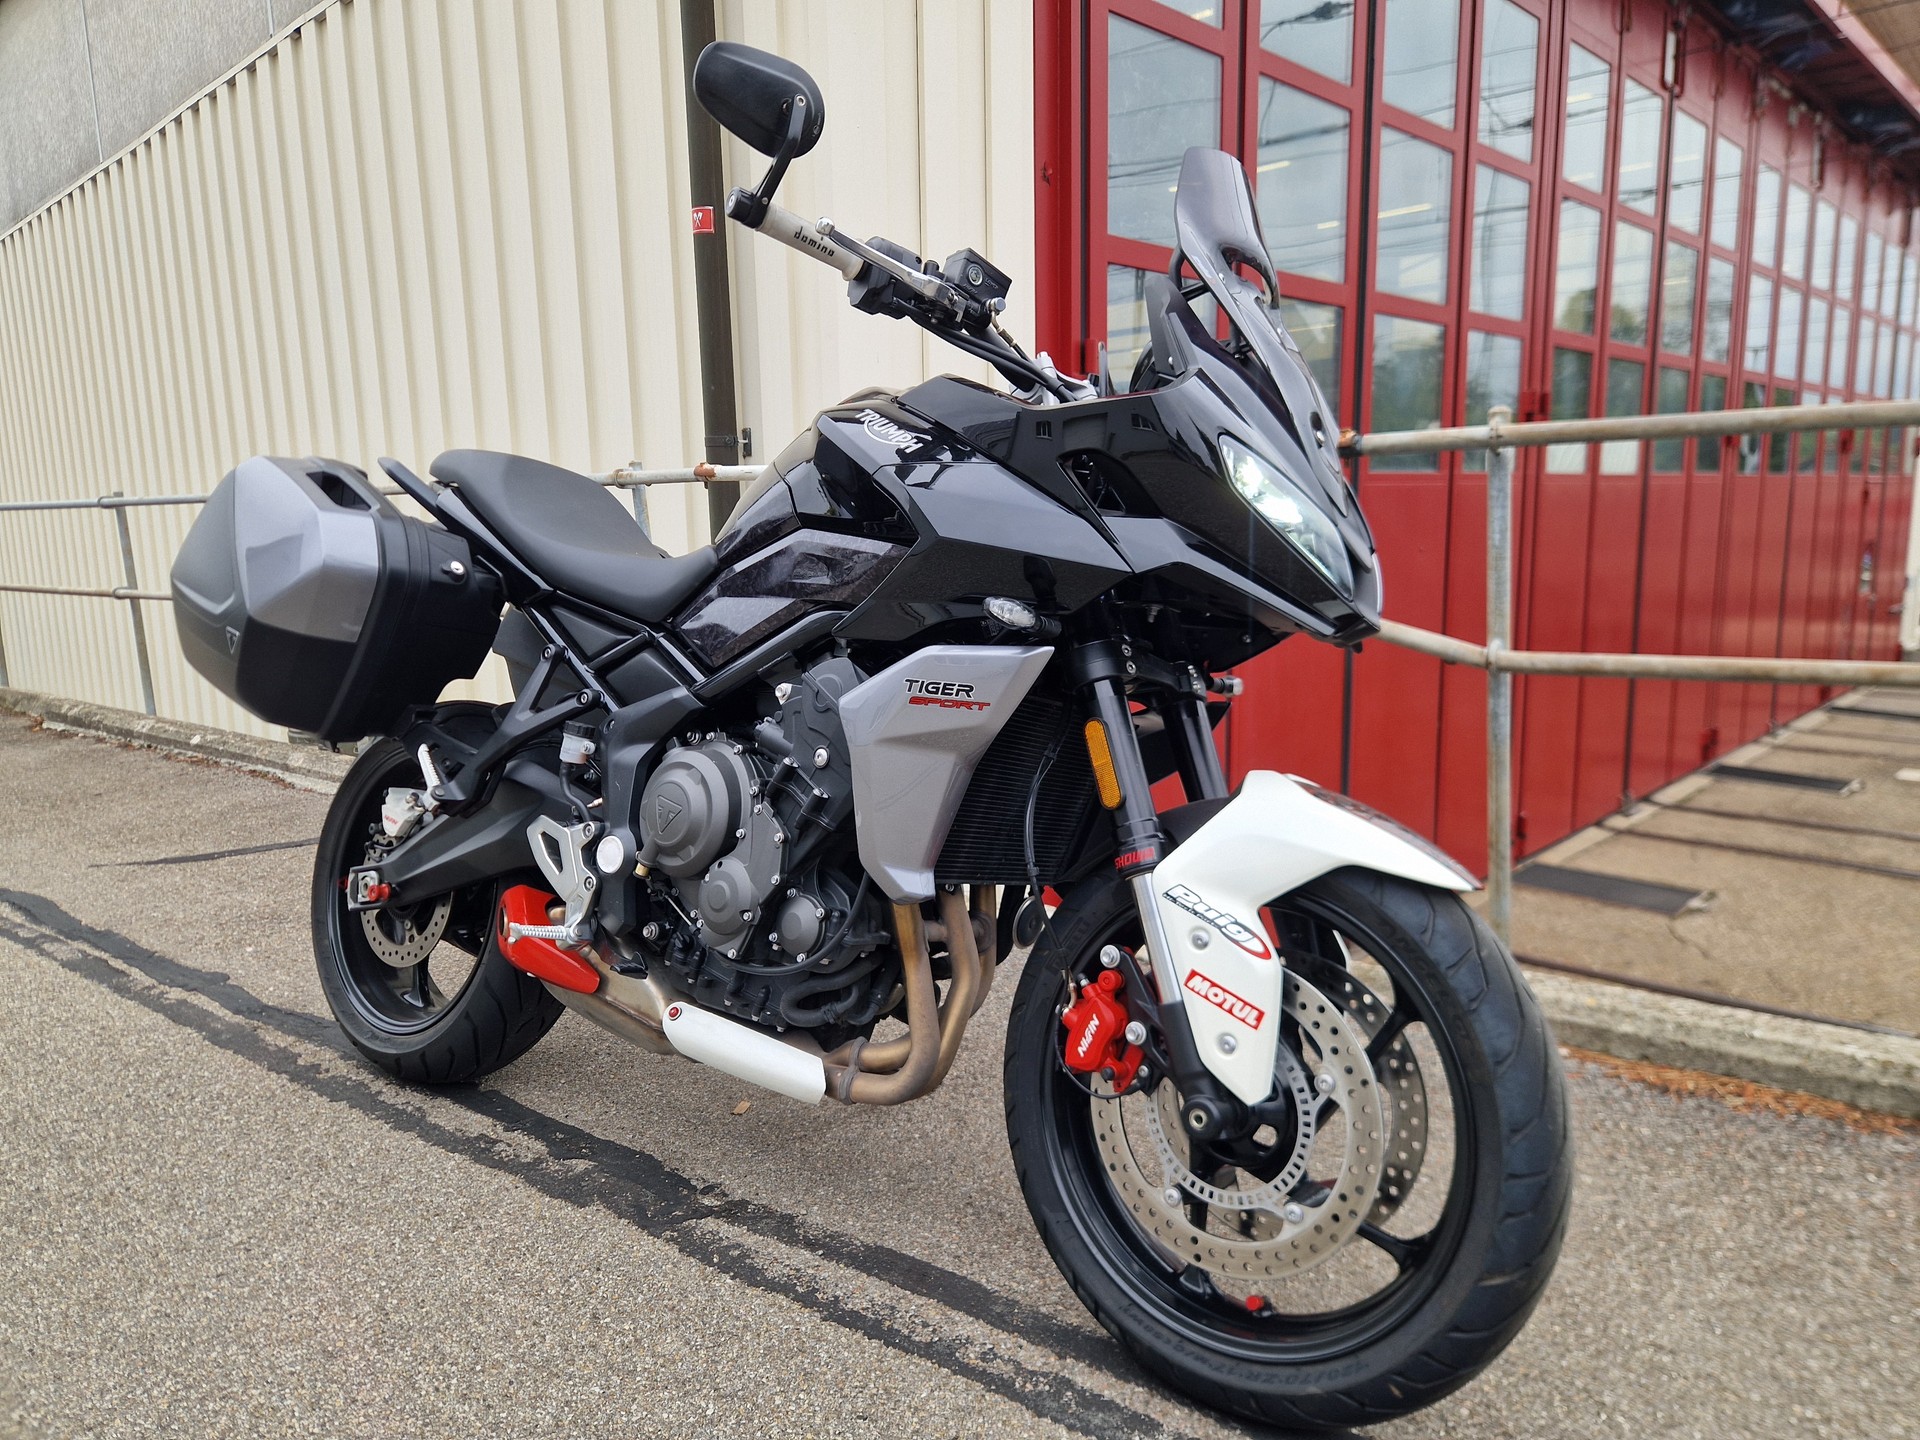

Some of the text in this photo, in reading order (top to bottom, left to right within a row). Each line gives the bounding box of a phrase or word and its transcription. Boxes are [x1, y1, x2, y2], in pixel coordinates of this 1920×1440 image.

[794, 226, 835, 257] domino
[855, 408, 926, 454] TRIUMPH
[904, 678, 975, 699] TIGER
[909, 696, 991, 711] SPORT
[1163, 884, 1257, 944] Puig
[1186, 974, 1260, 1027] MOTUL
